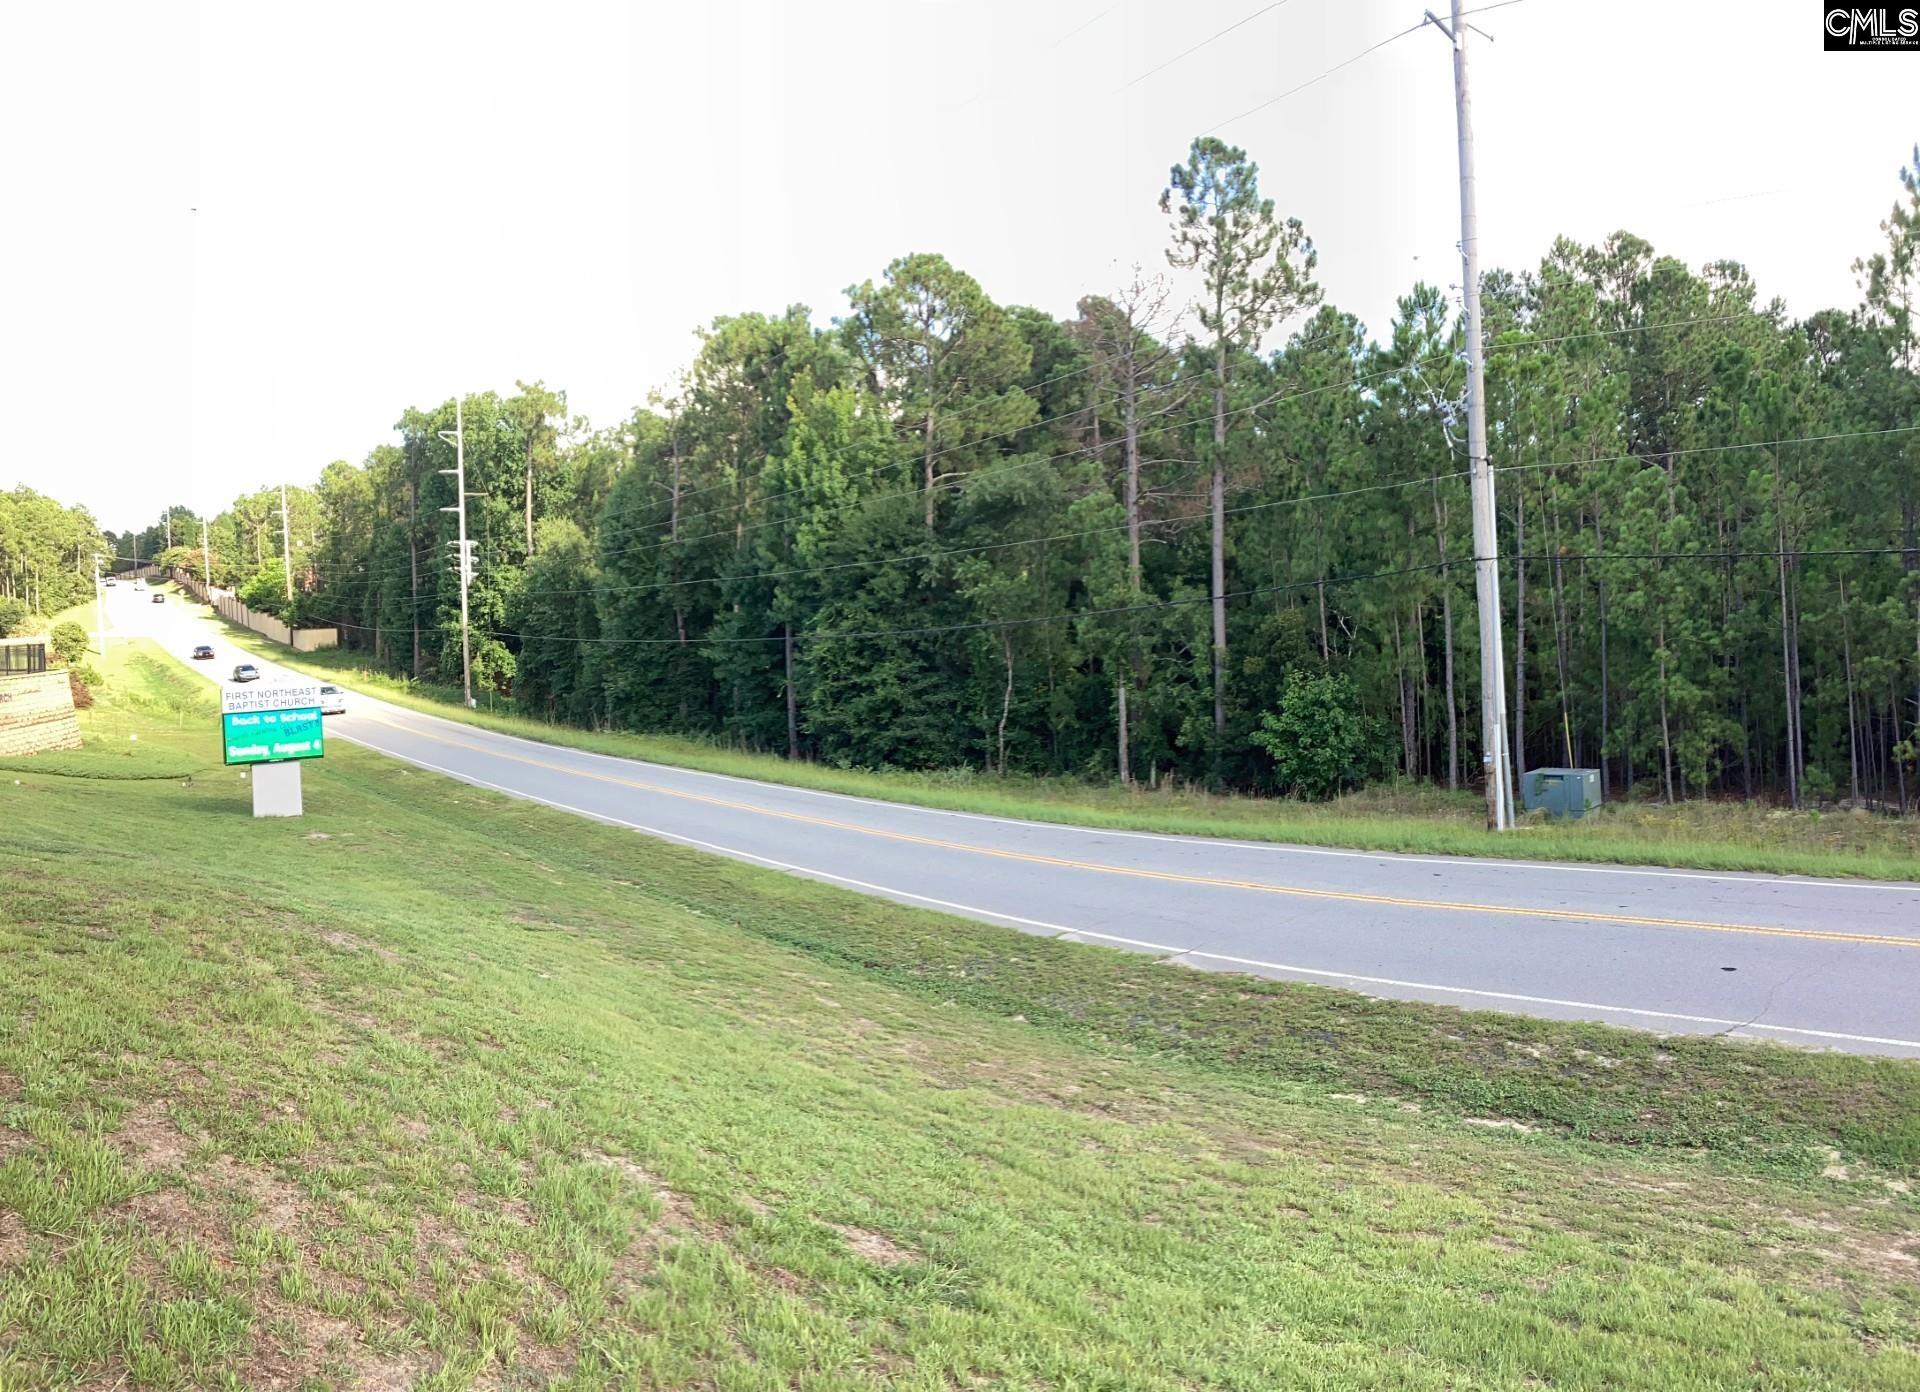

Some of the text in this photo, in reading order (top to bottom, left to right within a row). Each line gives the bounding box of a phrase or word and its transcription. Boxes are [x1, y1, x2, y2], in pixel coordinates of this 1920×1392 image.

[226, 687, 316, 700] FIRST NORTHEAST
[228, 697, 315, 710] BAPTIST CHURCH
[280, 712, 318, 722] School
